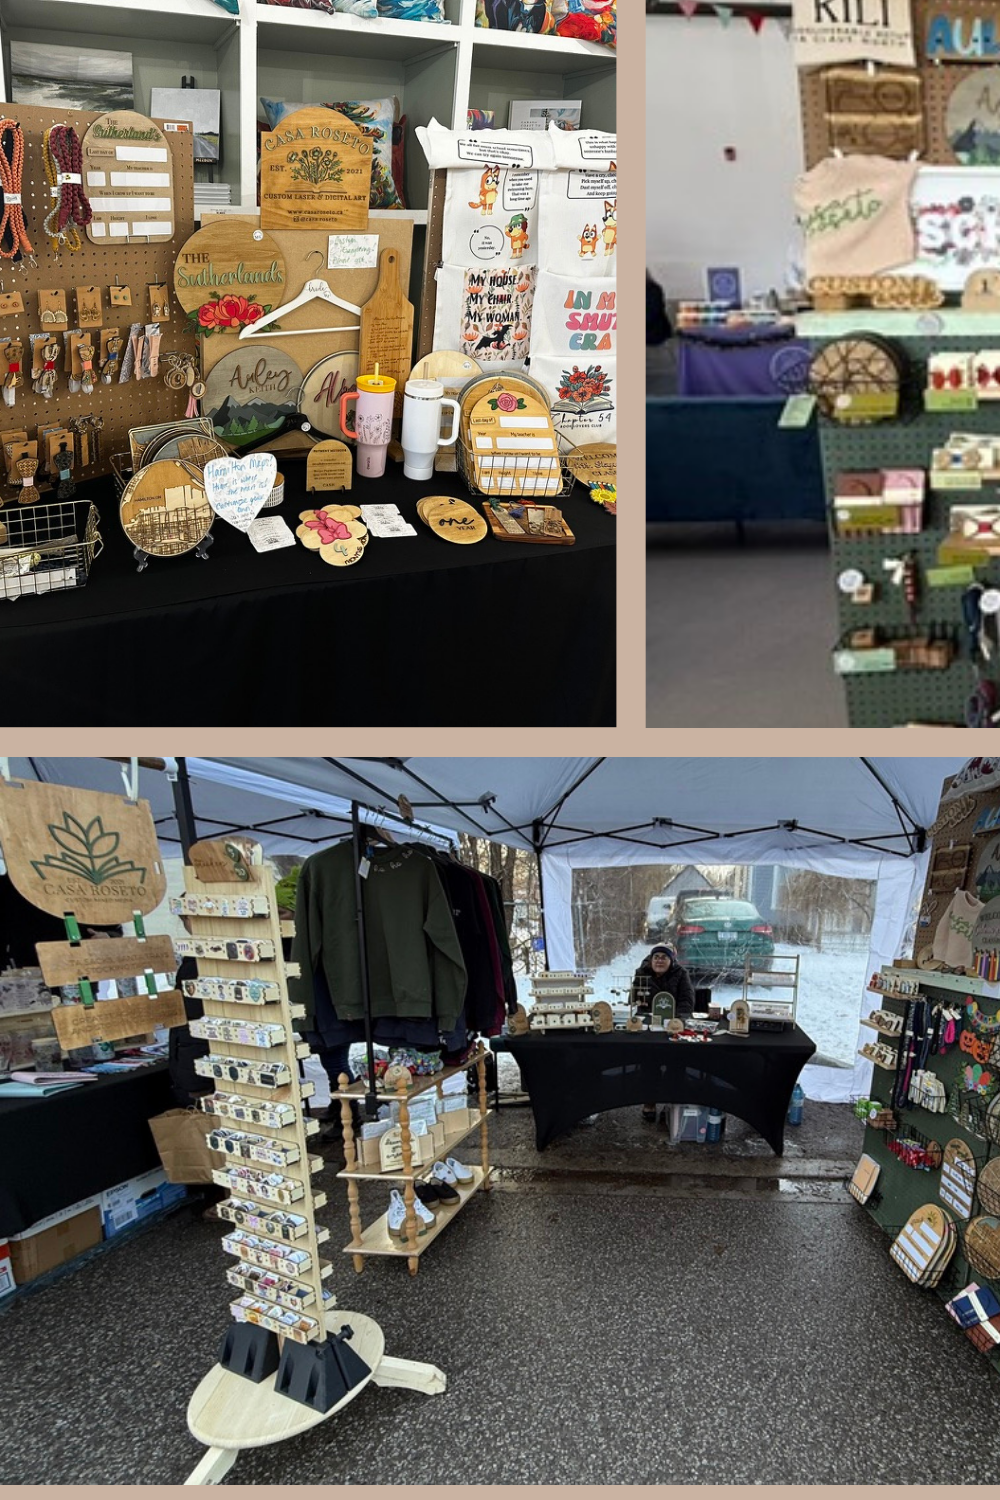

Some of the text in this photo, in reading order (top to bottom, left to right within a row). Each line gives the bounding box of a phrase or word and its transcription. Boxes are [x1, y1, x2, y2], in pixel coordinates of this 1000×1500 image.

[264, 126, 370, 155] CASA ROSETO
[182, 253, 209, 263] THE
[177, 262, 283, 288] Sutherlands
[469, 274, 486, 287] MY
[469, 293, 485, 305] MY
[564, 290, 593, 310] IN
[467, 311, 522, 323] MY WOMAN.
[568, 333, 612, 351] ERA
[249, 384, 276, 394] KEITH
[438, 516, 475, 526] one
[333, 543, 348, 556] 4
[43, 884, 147, 897] CASA ROSETO
